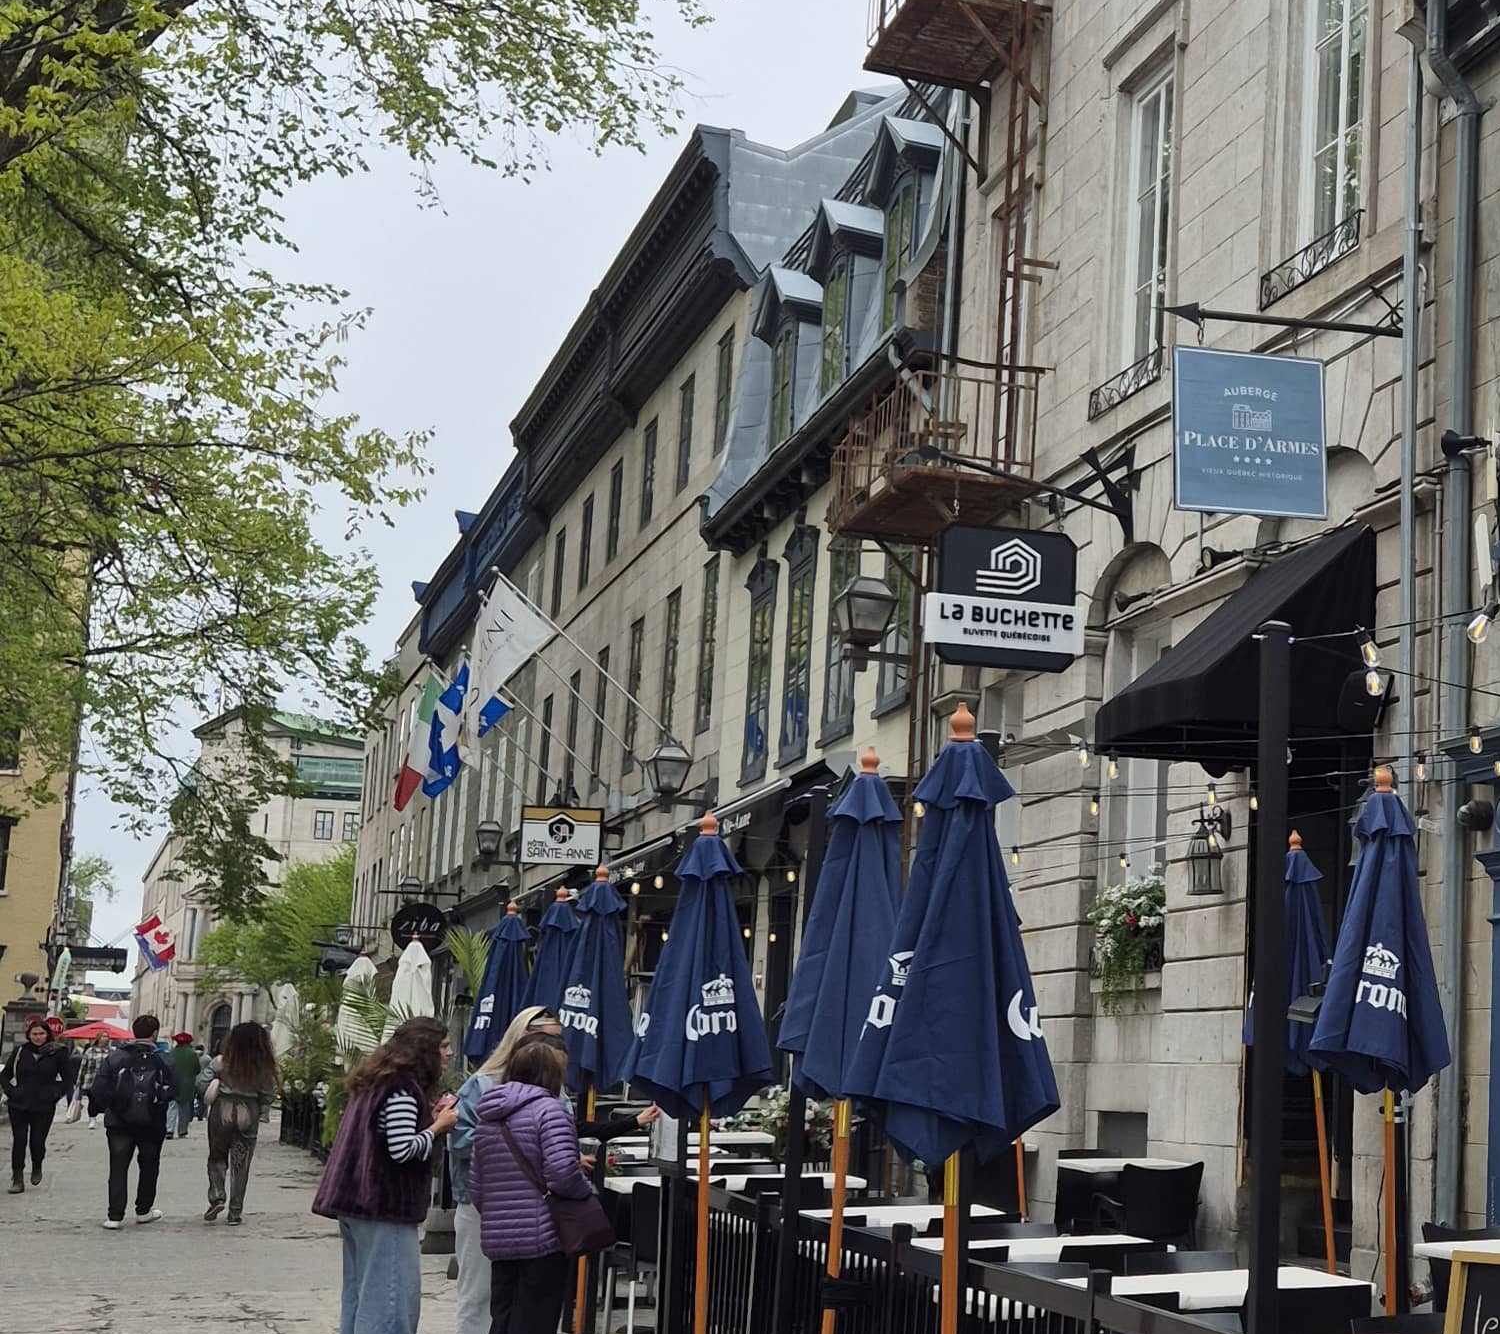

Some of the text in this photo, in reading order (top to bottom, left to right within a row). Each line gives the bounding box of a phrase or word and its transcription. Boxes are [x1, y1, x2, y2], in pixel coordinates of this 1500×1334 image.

[1223, 385, 1280, 402] AUBERGE
[1184, 430, 1320, 456] PLACE D'ARMES
[527, 839, 549, 848] HÔTEL
[526, 847, 595, 860] SAINTE-ANNE
